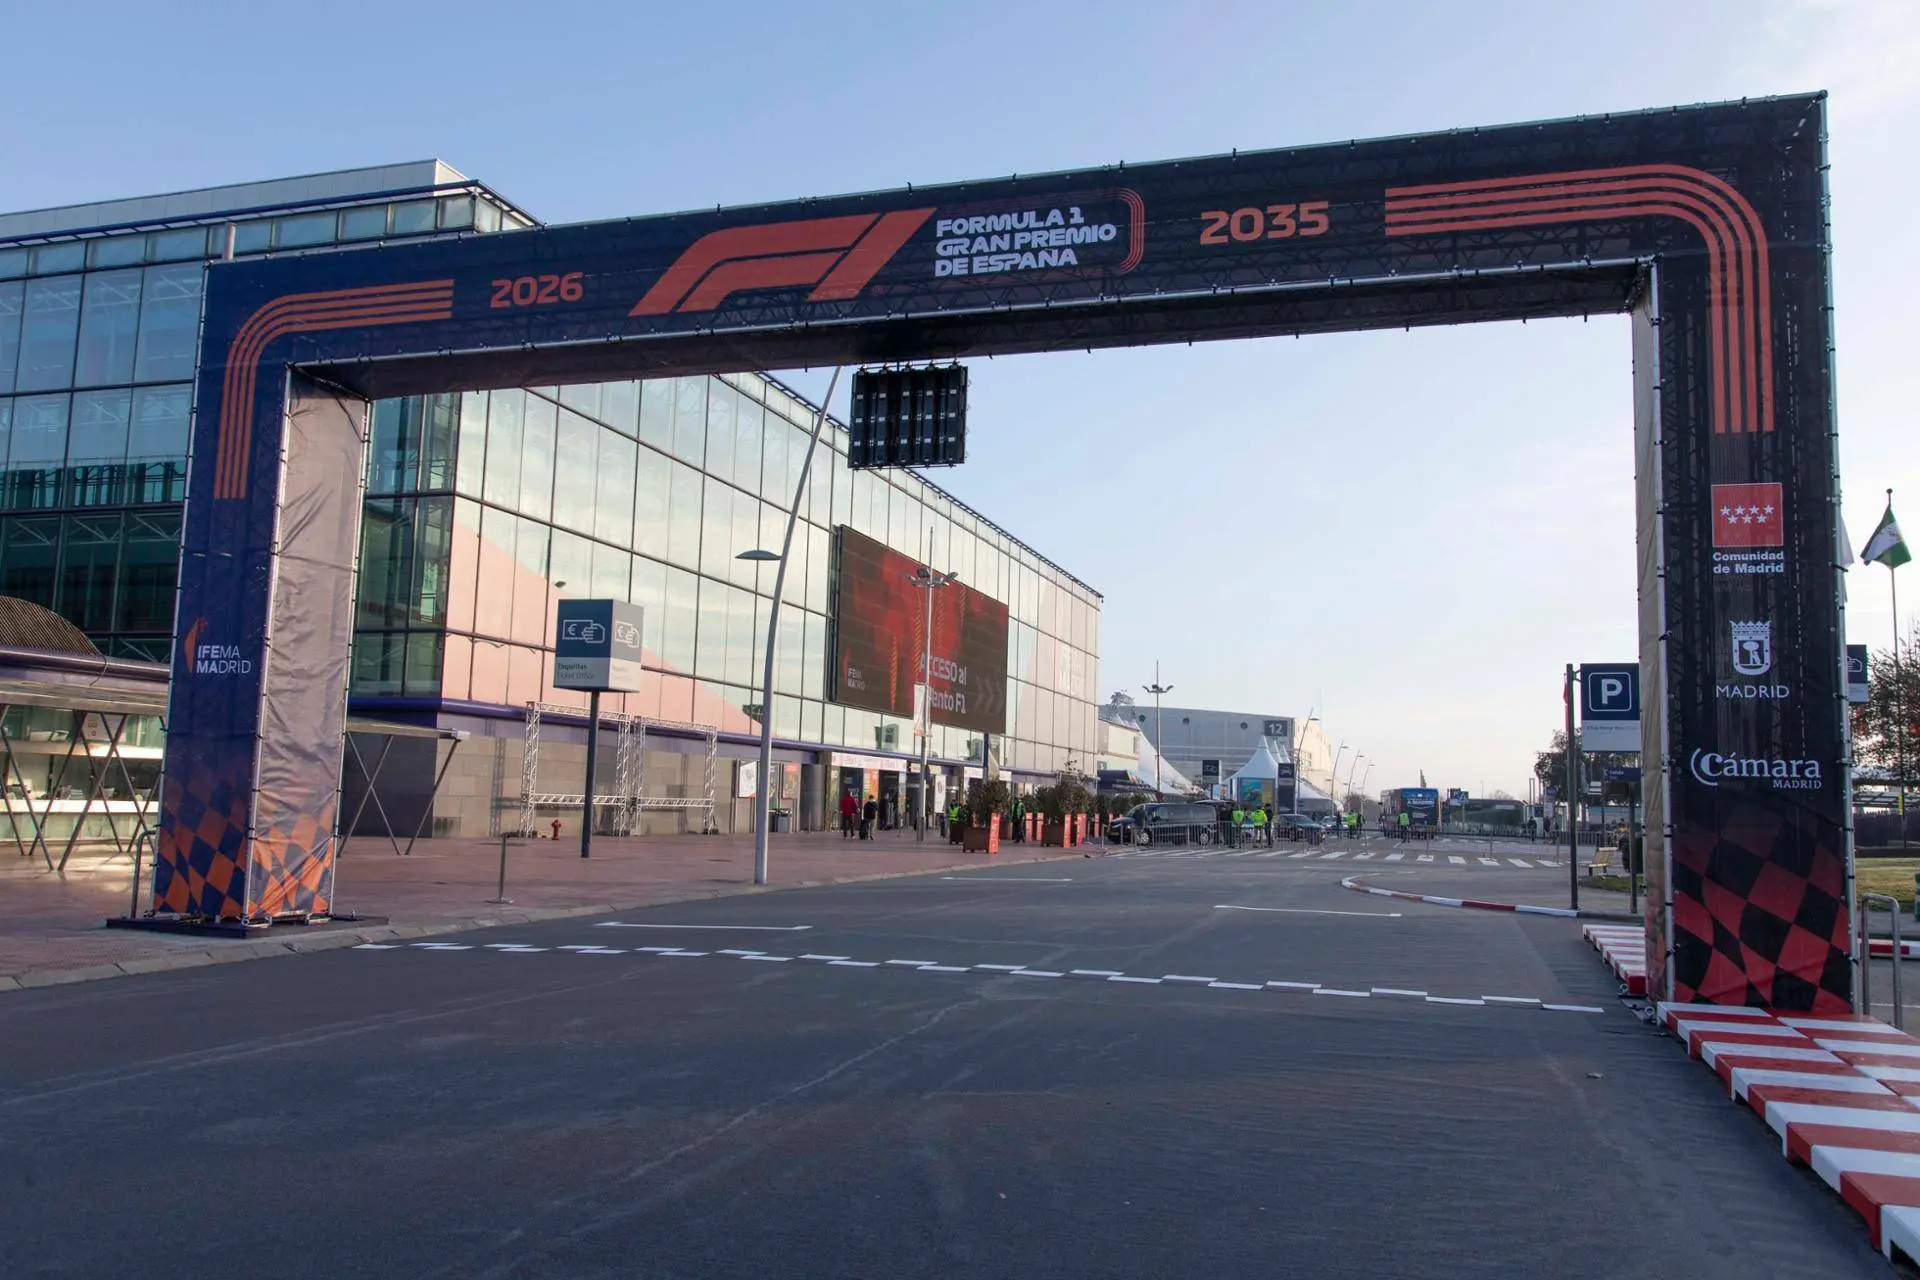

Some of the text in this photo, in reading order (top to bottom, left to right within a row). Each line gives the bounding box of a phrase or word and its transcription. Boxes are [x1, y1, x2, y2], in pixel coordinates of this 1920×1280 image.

[936, 207, 1085, 237] FORMULA 1
[1200, 201, 1329, 245] 2035
[935, 223, 1117, 257] GRAN PREMIO
[934, 248, 1078, 277] DE ESPAÑA
[490, 271, 584, 309] 2026
[1712, 551, 1784, 561] Comunidad
[1713, 562, 1784, 574] de Madrid
[197, 645, 240, 659] IFEMA
[196, 660, 252, 674] MADRID
[1601, 678, 1623, 705] P
[1716, 685, 1790, 699] MADRID
[1269, 723, 1284, 735] 12
[1700, 752, 1822, 779] Cámara
[1773, 780, 1822, 789] MADRID
